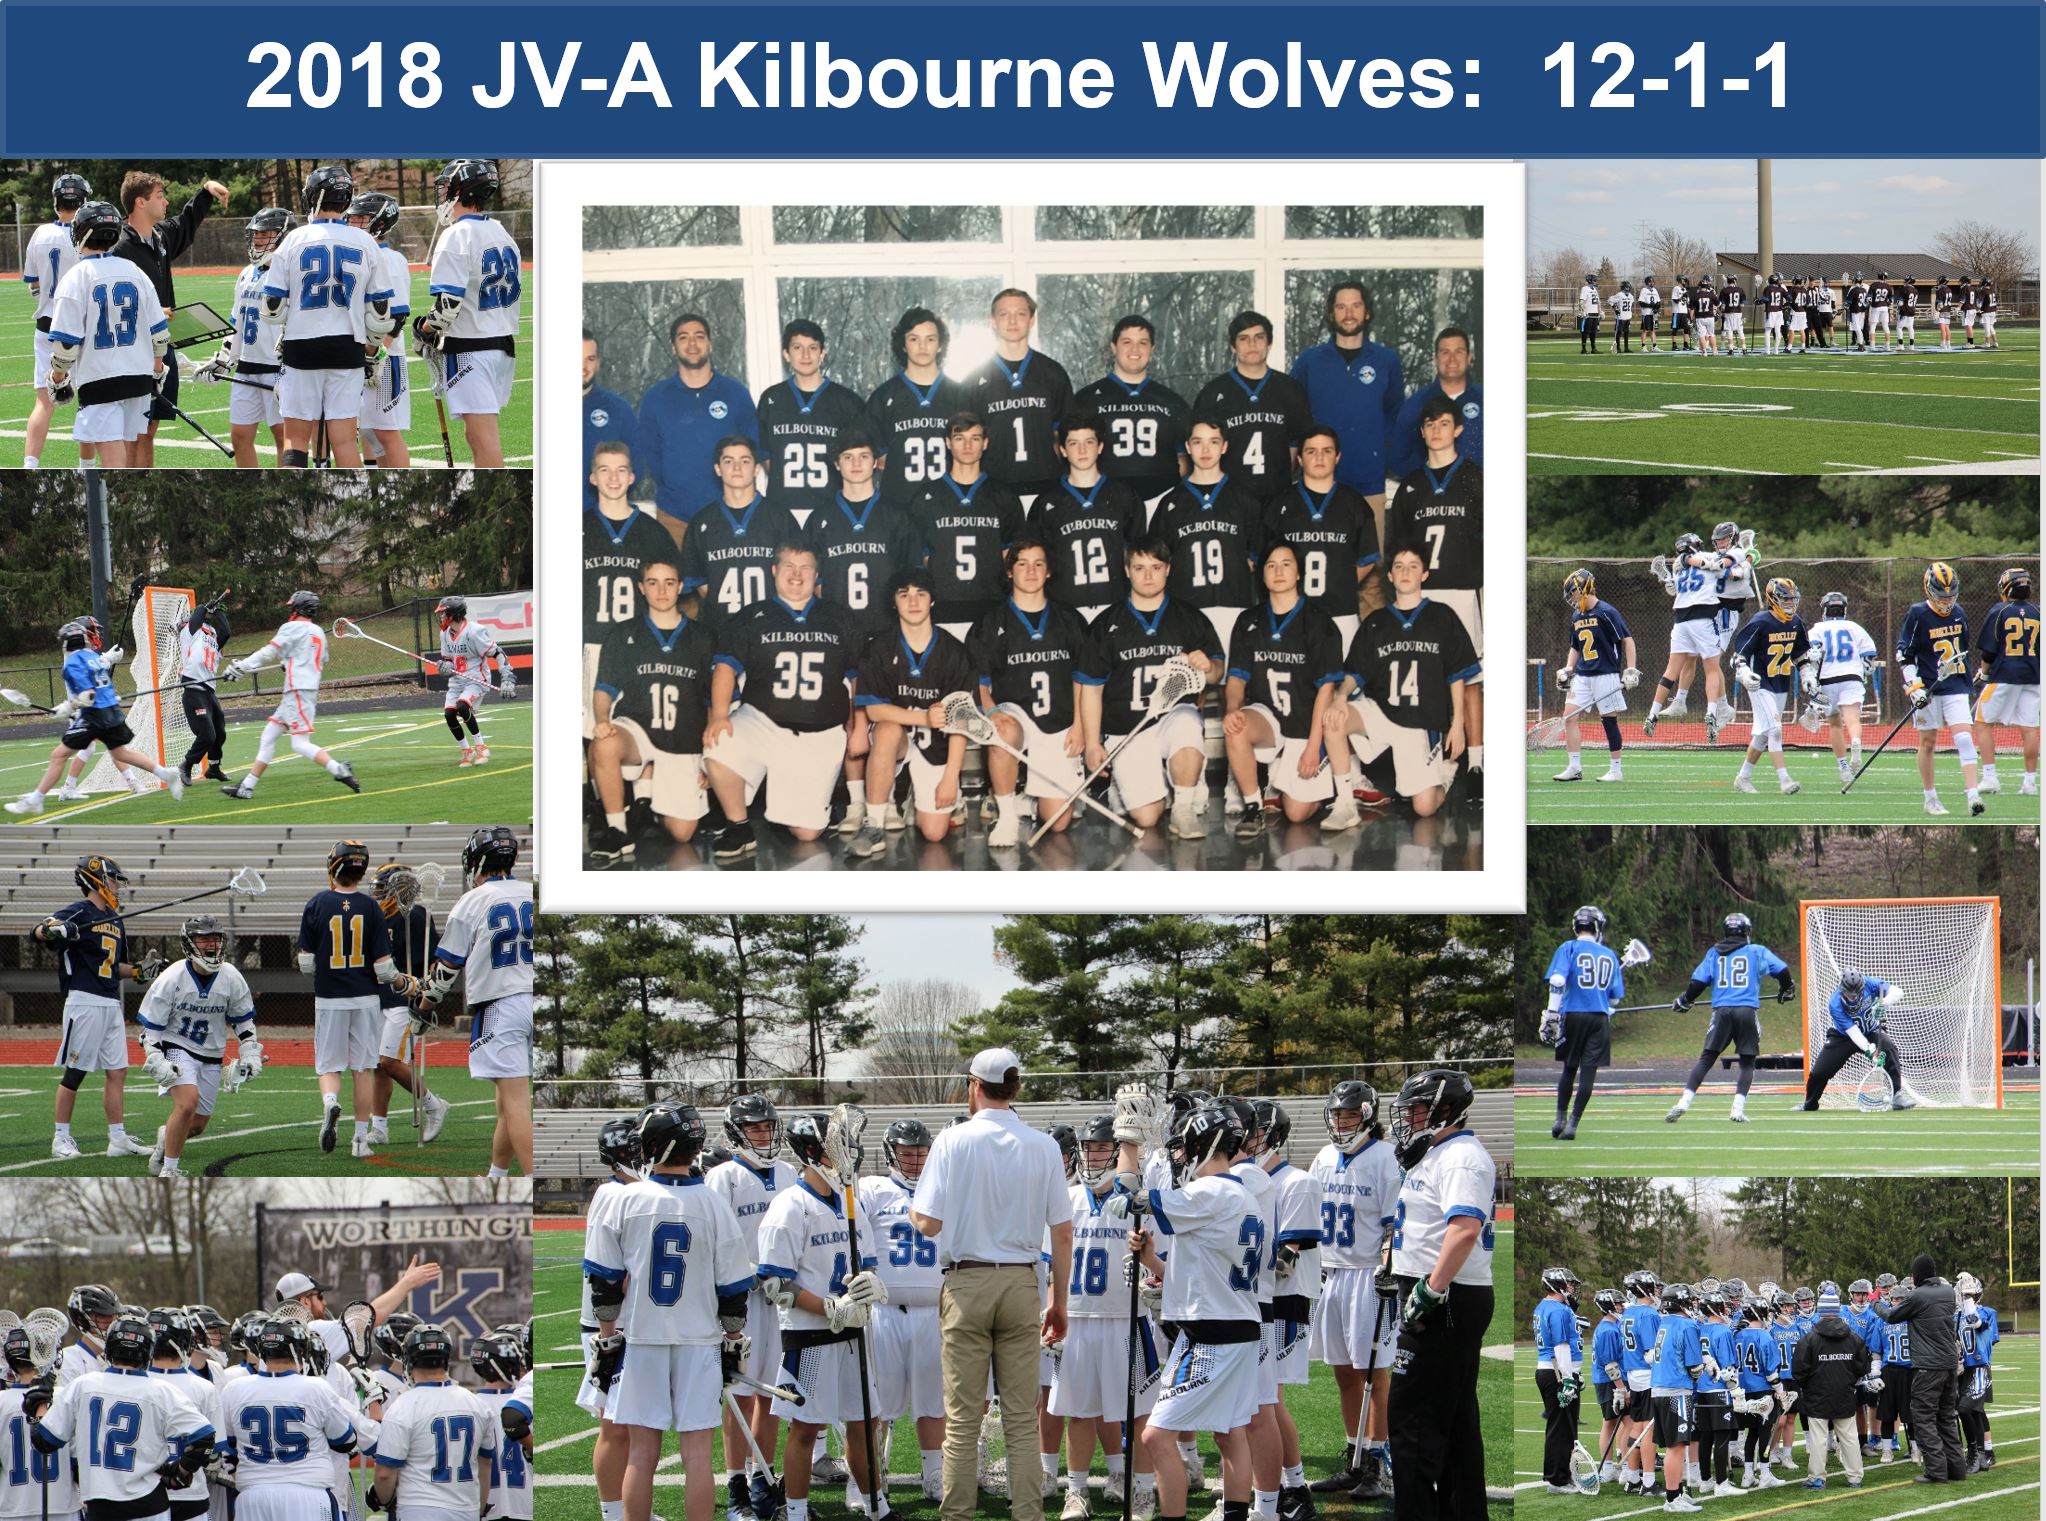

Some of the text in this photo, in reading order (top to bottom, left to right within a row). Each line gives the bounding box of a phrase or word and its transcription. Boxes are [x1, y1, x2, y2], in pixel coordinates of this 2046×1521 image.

[300, 244, 363, 310] 25
[478, 246, 521, 311] 29
[1728, 292, 1740, 307] 19
[1770, 291, 1781, 306] 12
[1794, 292, 1807, 307] 40
[92, 281, 139, 350] 13
[1698, 297, 1710, 312] 17
[988, 397, 1047, 413] KILBOURNE
[1098, 404, 1171, 417] KILBOURNE
[773, 424, 838, 438] KILBOURNE
[1013, 417, 1028, 462] 1
[1112, 418, 1158, 457] 39
[1243, 431, 1265, 475] 4
[783, 443, 829, 488] 25
[904, 437, 946, 482] 33
[955, 535, 976, 581] 5
[1071, 537, 1110, 585] 12
[1191, 539, 1224, 587] 19
[1425, 525, 1446, 570] 7
[718, 567, 766, 614] 40
[848, 563, 869, 611] 6
[1304, 551, 1327, 597] 8
[596, 576, 635, 623] 18
[312, 634, 324, 673] 7
[761, 632, 841, 646] KILBOURNE
[1119, 645, 1184, 660] KILBOURNE
[1578, 629, 1599, 662] 2
[1824, 629, 1854, 663] 16
[2004, 617, 2041, 657] 27
[773, 652, 826, 701] 35
[1767, 643, 1794, 678] 22
[1030, 670, 1050, 717] 3
[1388, 660, 1420, 707] 14
[650, 683, 680, 731] 16
[99, 935, 118, 979] 7
[329, 914, 365, 970] 11
[487, 901, 532, 970] 29
[1577, 953, 1604, 991] 30
[1717, 955, 1748, 988] 12
[1192, 1115, 1209, 1136] 10
[889, 1222, 938, 1268] 35
[1321, 1201, 1356, 1248] 33
[648, 1221, 692, 1307] 6
[1069, 1246, 1109, 1297] 18
[398, 1267, 504, 1361] K
[1624, 1318, 1637, 1352] 5
[1655, 1328, 1667, 1363] 8
[1736, 1342, 1760, 1374] 14
[1818, 1353, 1854, 1362] KILBOURNE
[1888, 1334, 1910, 1362] 18
[89, 1396, 142, 1472] 12
[240, 1406, 310, 1464] 35
[431, 1415, 475, 1483] 17
